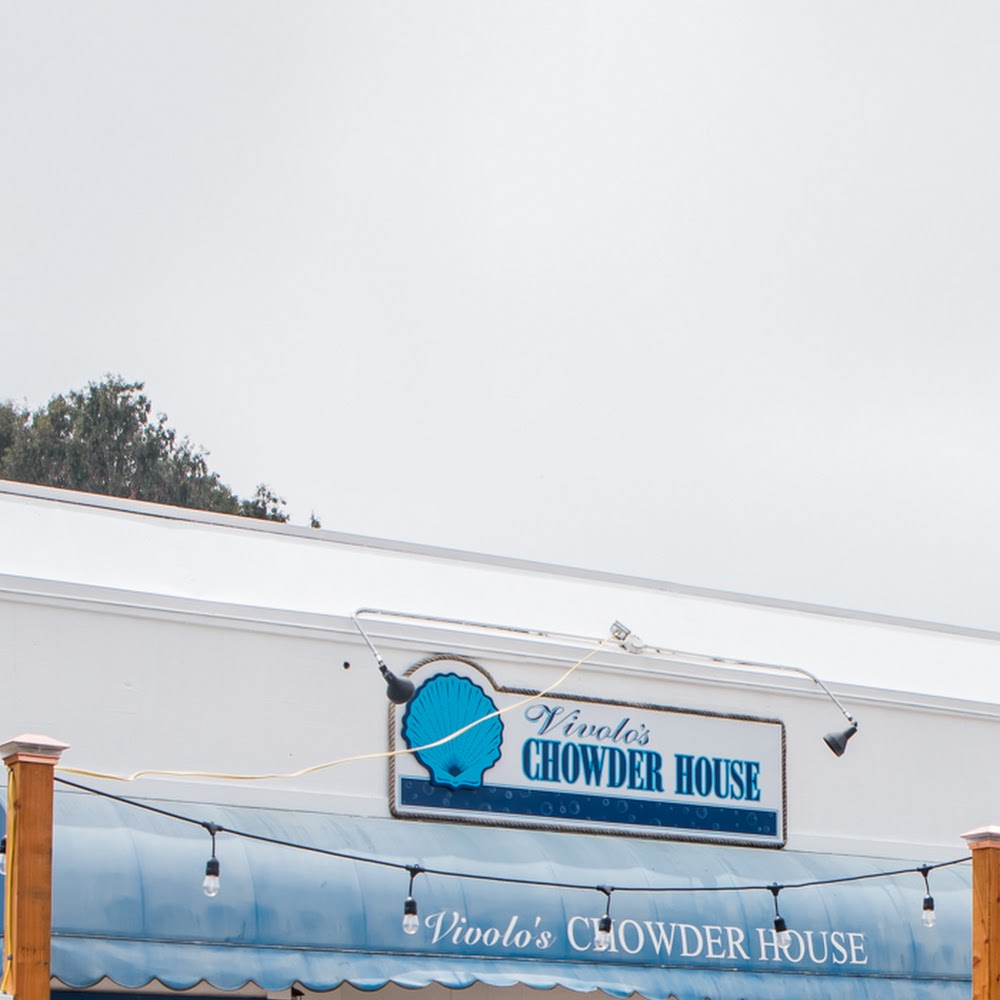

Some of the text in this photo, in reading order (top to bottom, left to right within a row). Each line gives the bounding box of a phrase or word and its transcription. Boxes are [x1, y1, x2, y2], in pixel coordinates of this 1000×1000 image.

[524, 703, 650, 746] Vivolo's
[521, 738, 761, 801] CHOWDER HOUSE
[424, 911, 868, 965] Vivolo's CHOWDER HOUSE
